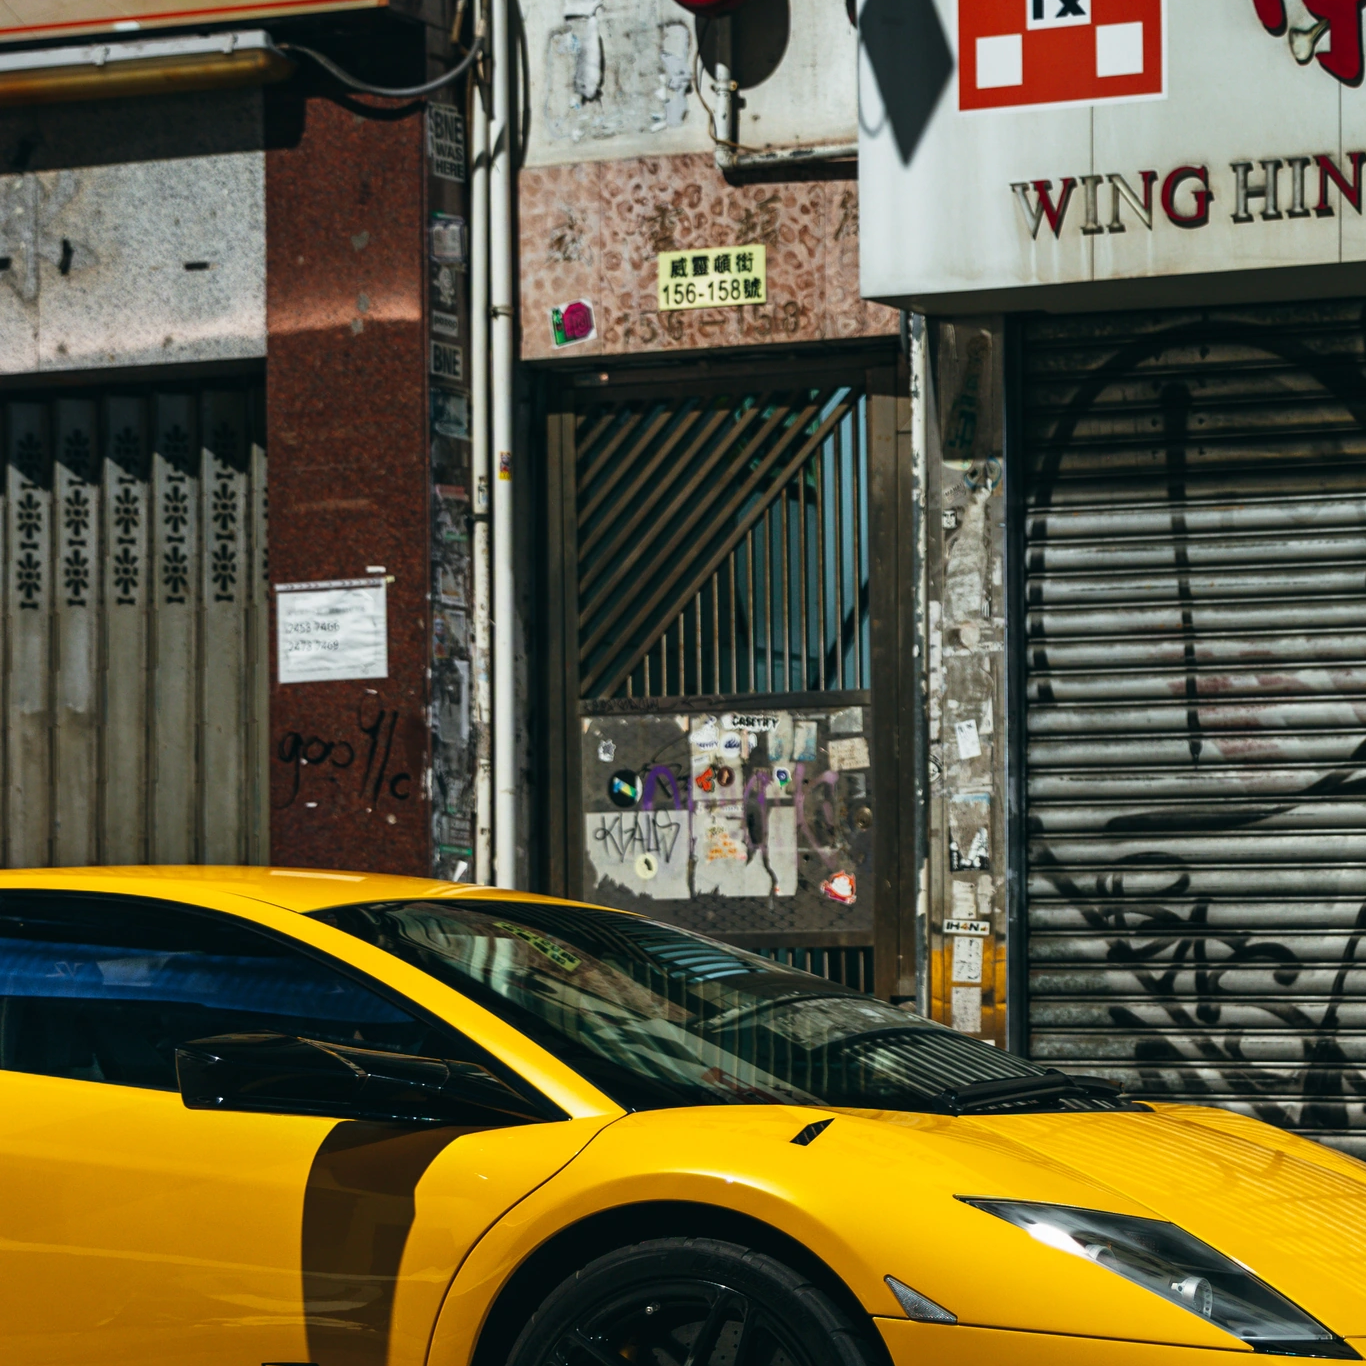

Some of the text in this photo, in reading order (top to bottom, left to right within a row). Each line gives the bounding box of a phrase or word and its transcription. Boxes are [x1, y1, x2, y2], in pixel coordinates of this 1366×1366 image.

[435, 111, 464, 144] BNE
[436, 142, 464, 162] WAS
[436, 159, 465, 179] HERE
[1010, 164, 1214, 239] WING
[669, 252, 754, 279] 威靈頓街
[433, 344, 461, 376] BNE
